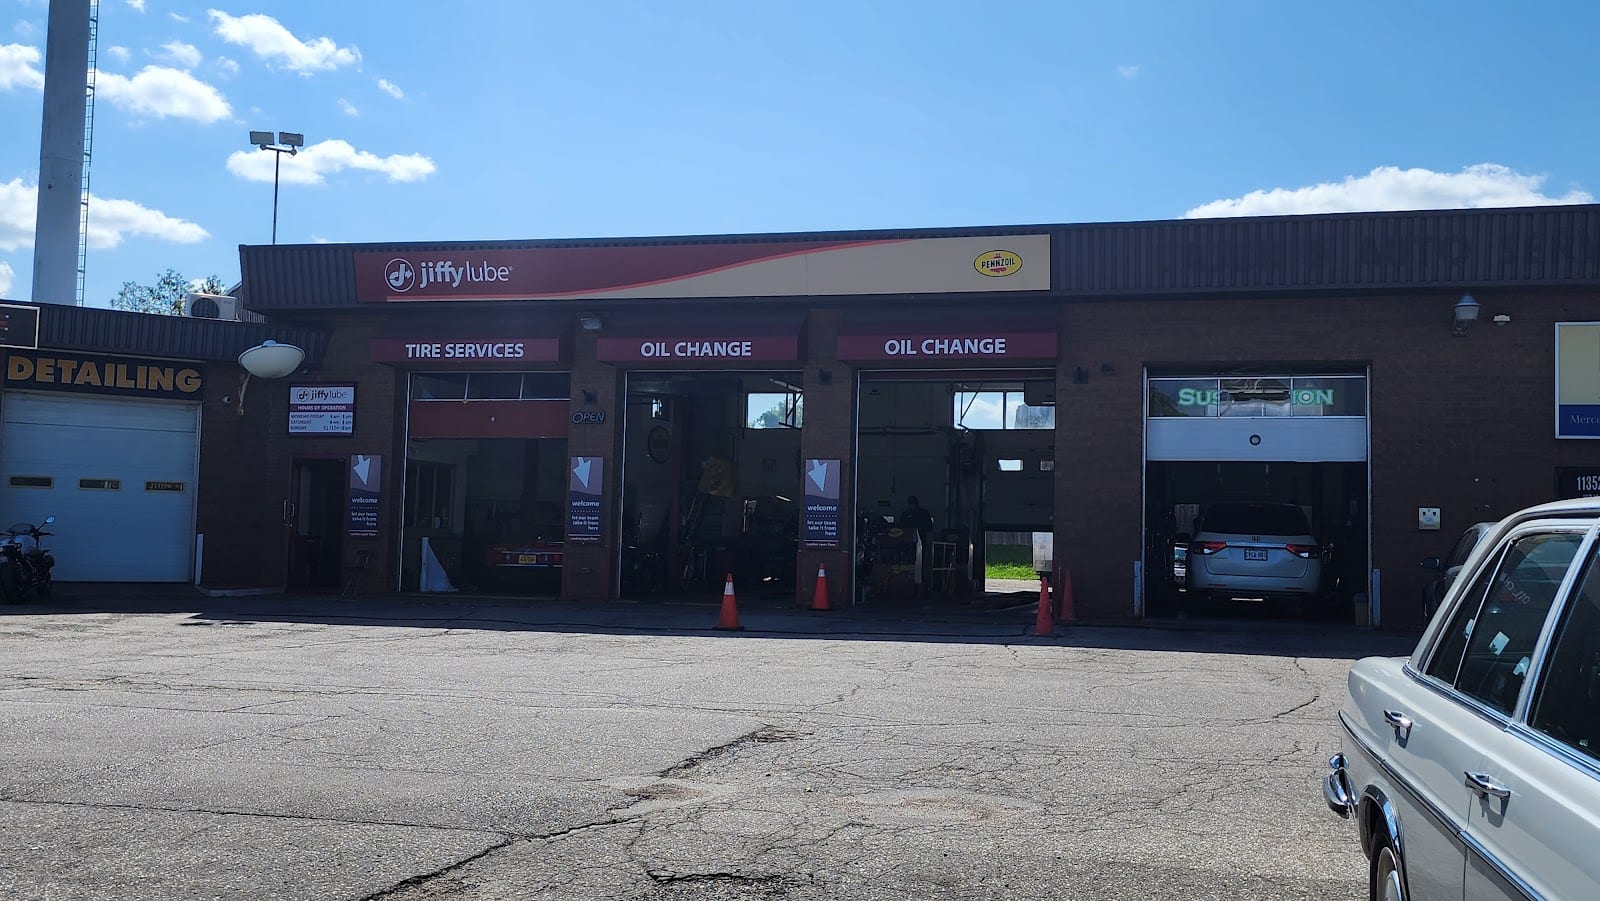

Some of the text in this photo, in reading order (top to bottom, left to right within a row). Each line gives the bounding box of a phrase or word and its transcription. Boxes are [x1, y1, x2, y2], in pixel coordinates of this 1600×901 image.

[981, 257, 1016, 269] PENNZOIL
[405, 343, 524, 358] TIRE SERVICES
[640, 341, 752, 357] OIL CHANGE
[884, 338, 1006, 355] OIL CHANGE
[7, 355, 202, 393] DETAILING
[572, 412, 605, 423] OPEN
[807, 504, 838, 512] welcome
